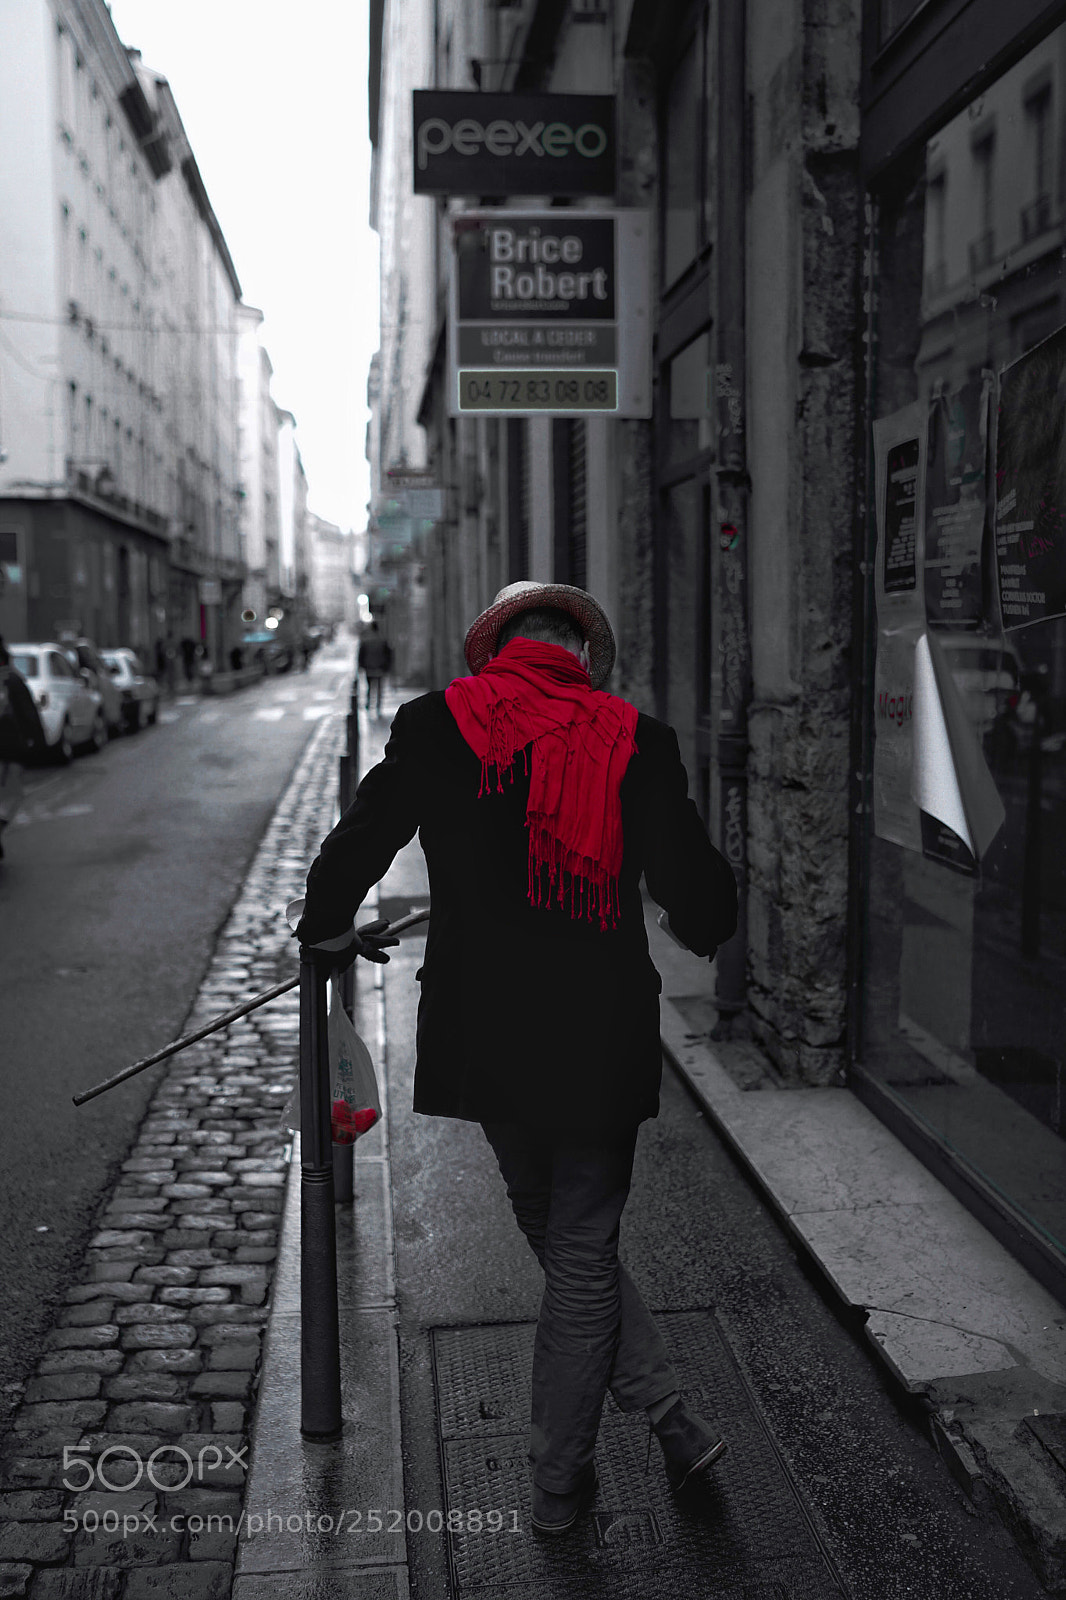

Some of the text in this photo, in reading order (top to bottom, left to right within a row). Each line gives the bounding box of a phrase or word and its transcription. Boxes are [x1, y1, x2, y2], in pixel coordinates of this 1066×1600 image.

[417, 117, 608, 171] peexeo
[490, 227, 583, 263] Brice
[490, 264, 608, 300] Robert
[468, 380, 609, 402] 04 72 83 08 08
